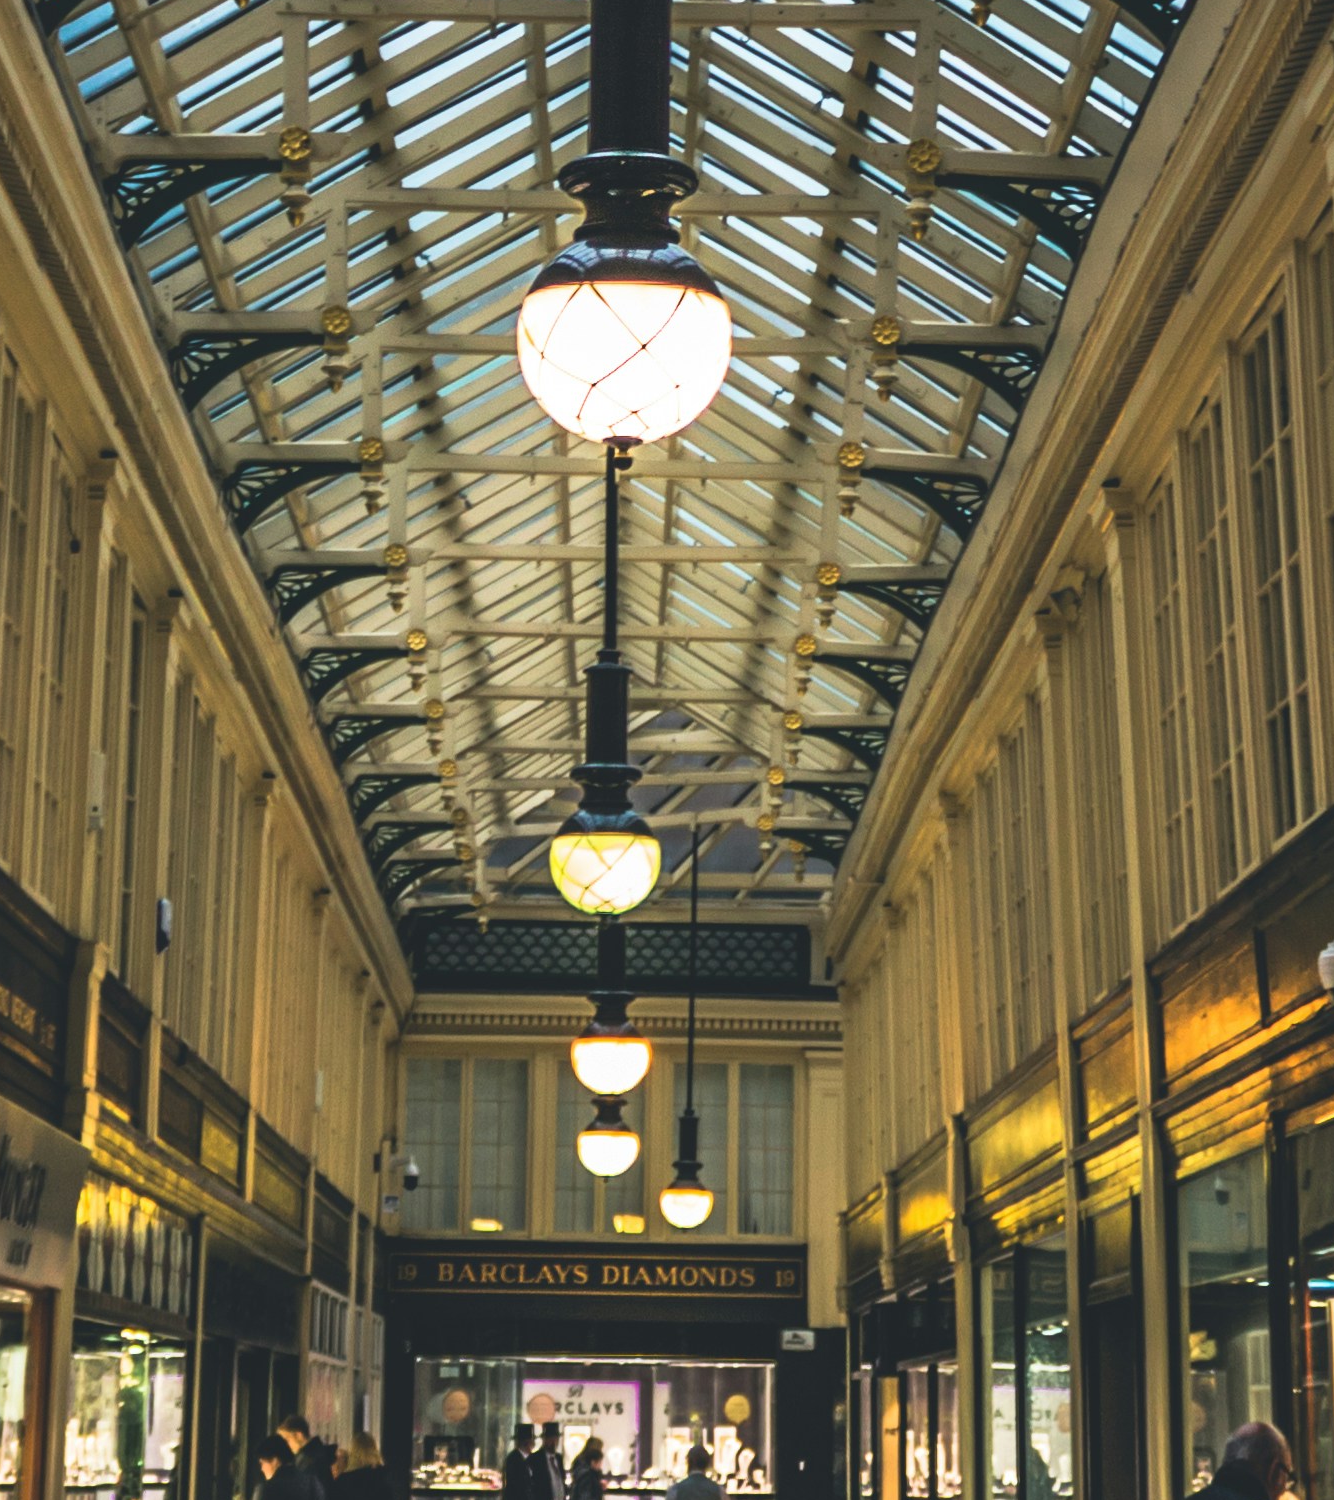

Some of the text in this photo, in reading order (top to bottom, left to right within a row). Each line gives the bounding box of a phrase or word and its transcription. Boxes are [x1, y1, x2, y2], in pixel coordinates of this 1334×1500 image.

[397, 1264, 796, 1289] 19 BARCLAYS DIAMONDS 19
[539, 1401, 624, 1416] RCLAYS
